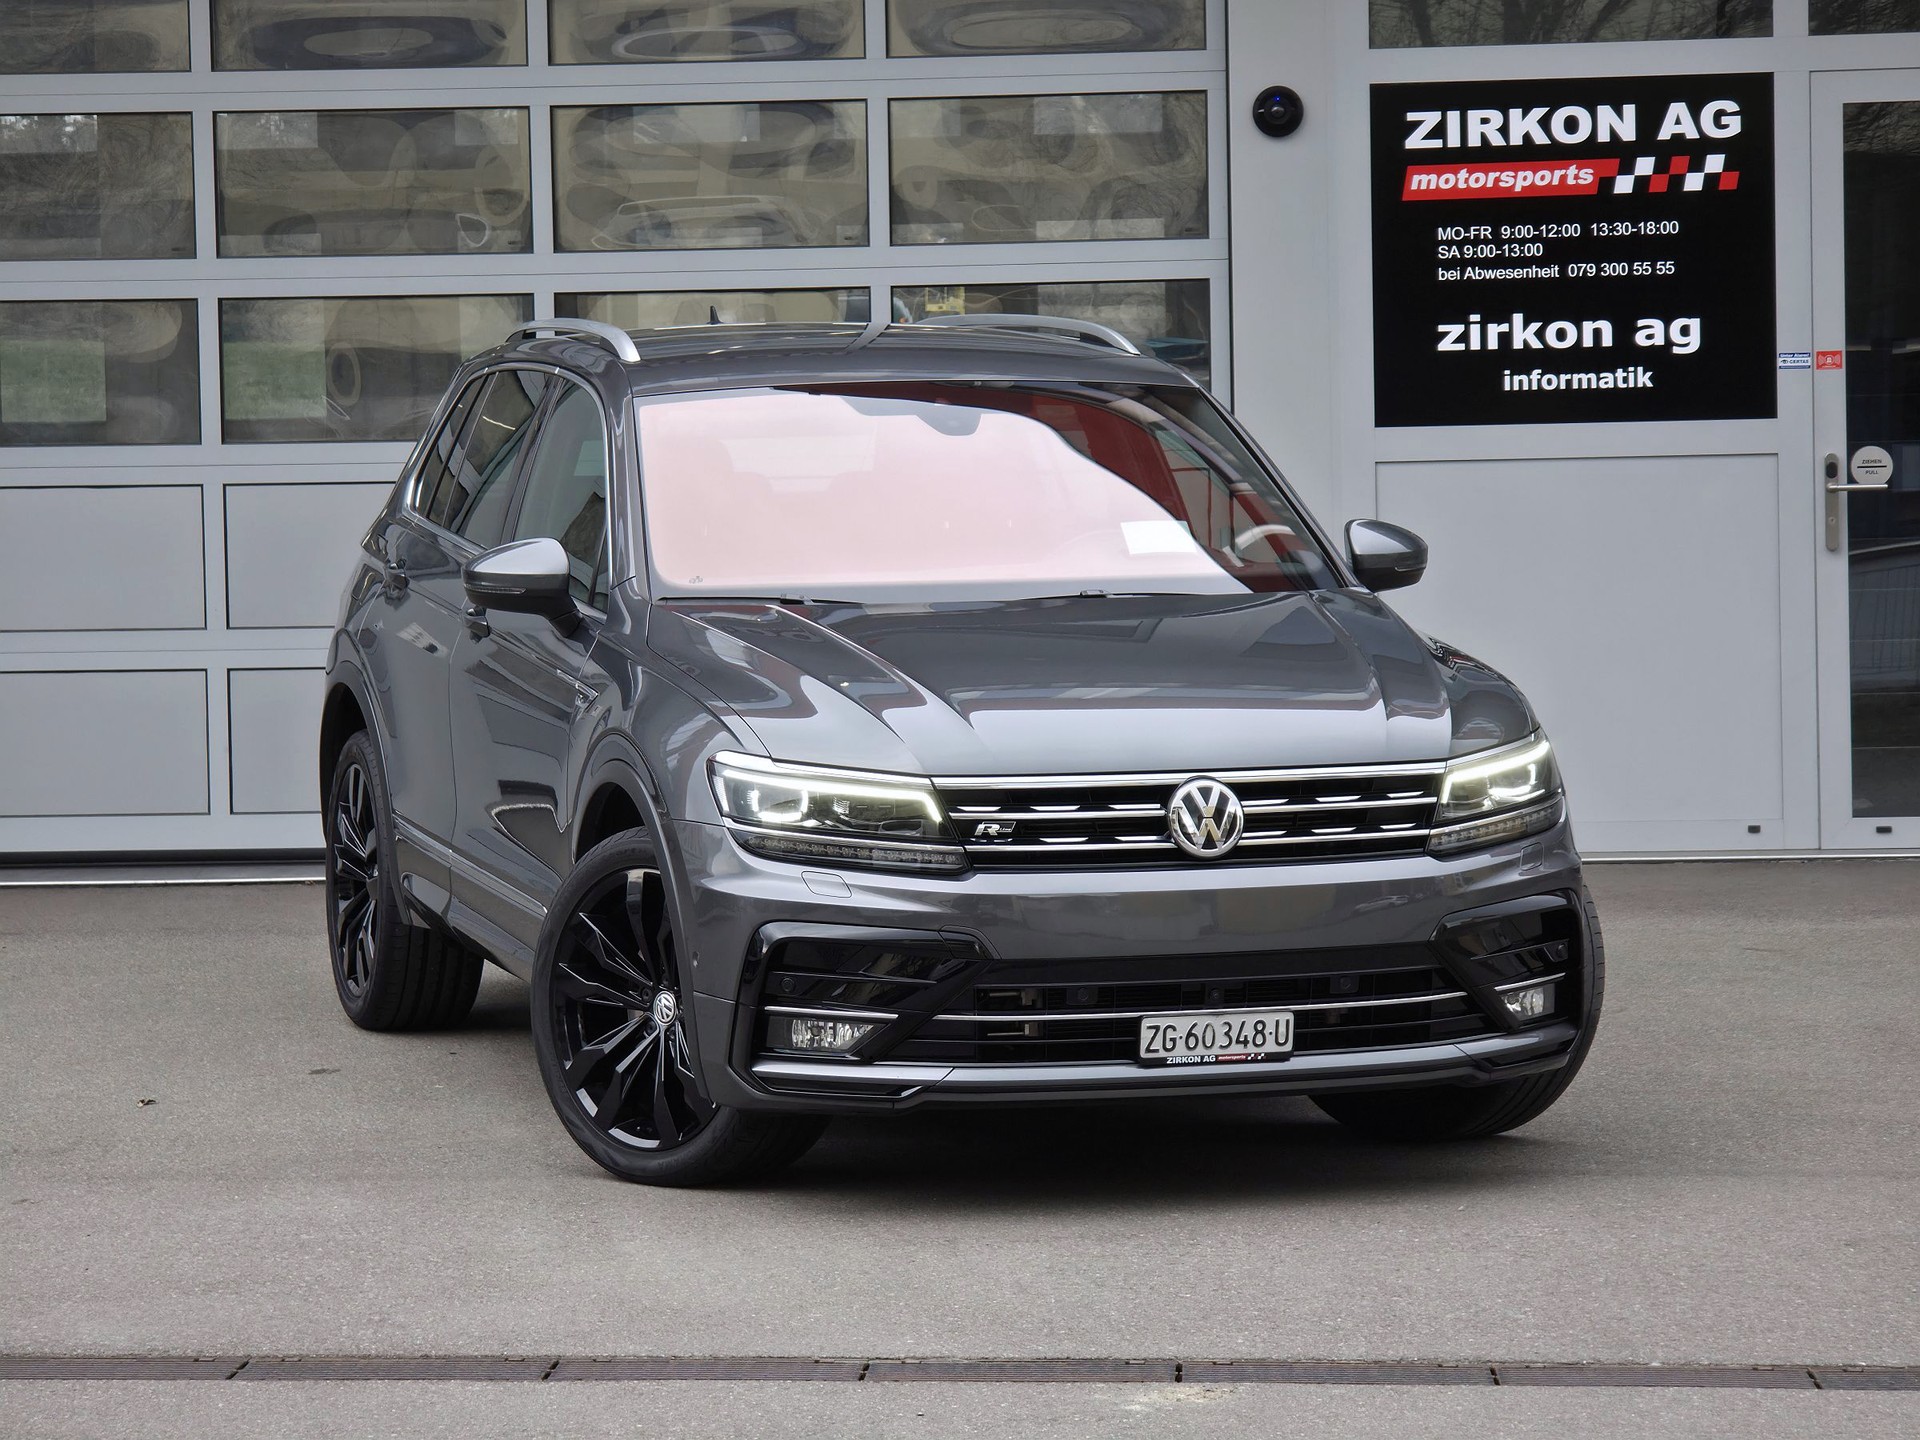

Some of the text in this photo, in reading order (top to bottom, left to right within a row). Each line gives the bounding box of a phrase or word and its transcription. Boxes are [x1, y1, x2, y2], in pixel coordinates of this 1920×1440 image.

[1404, 99, 1742, 150] ZIRKON AG
[1410, 164, 1594, 192] motorsports
[1437, 220, 1679, 241] MO-FR 9:00-12:00 13:30-18:00
[1437, 243, 1544, 259] SA 9:00-13:00
[1438, 260, 1675, 281] bei Abwesenheit 079 300 55 55
[1437, 312, 1701, 355] zirkon ag
[1503, 366, 1654, 391] informatik
[1166, 1055, 1201, 1064] ZIRKON
[1203, 1053, 1216, 1063] AG
